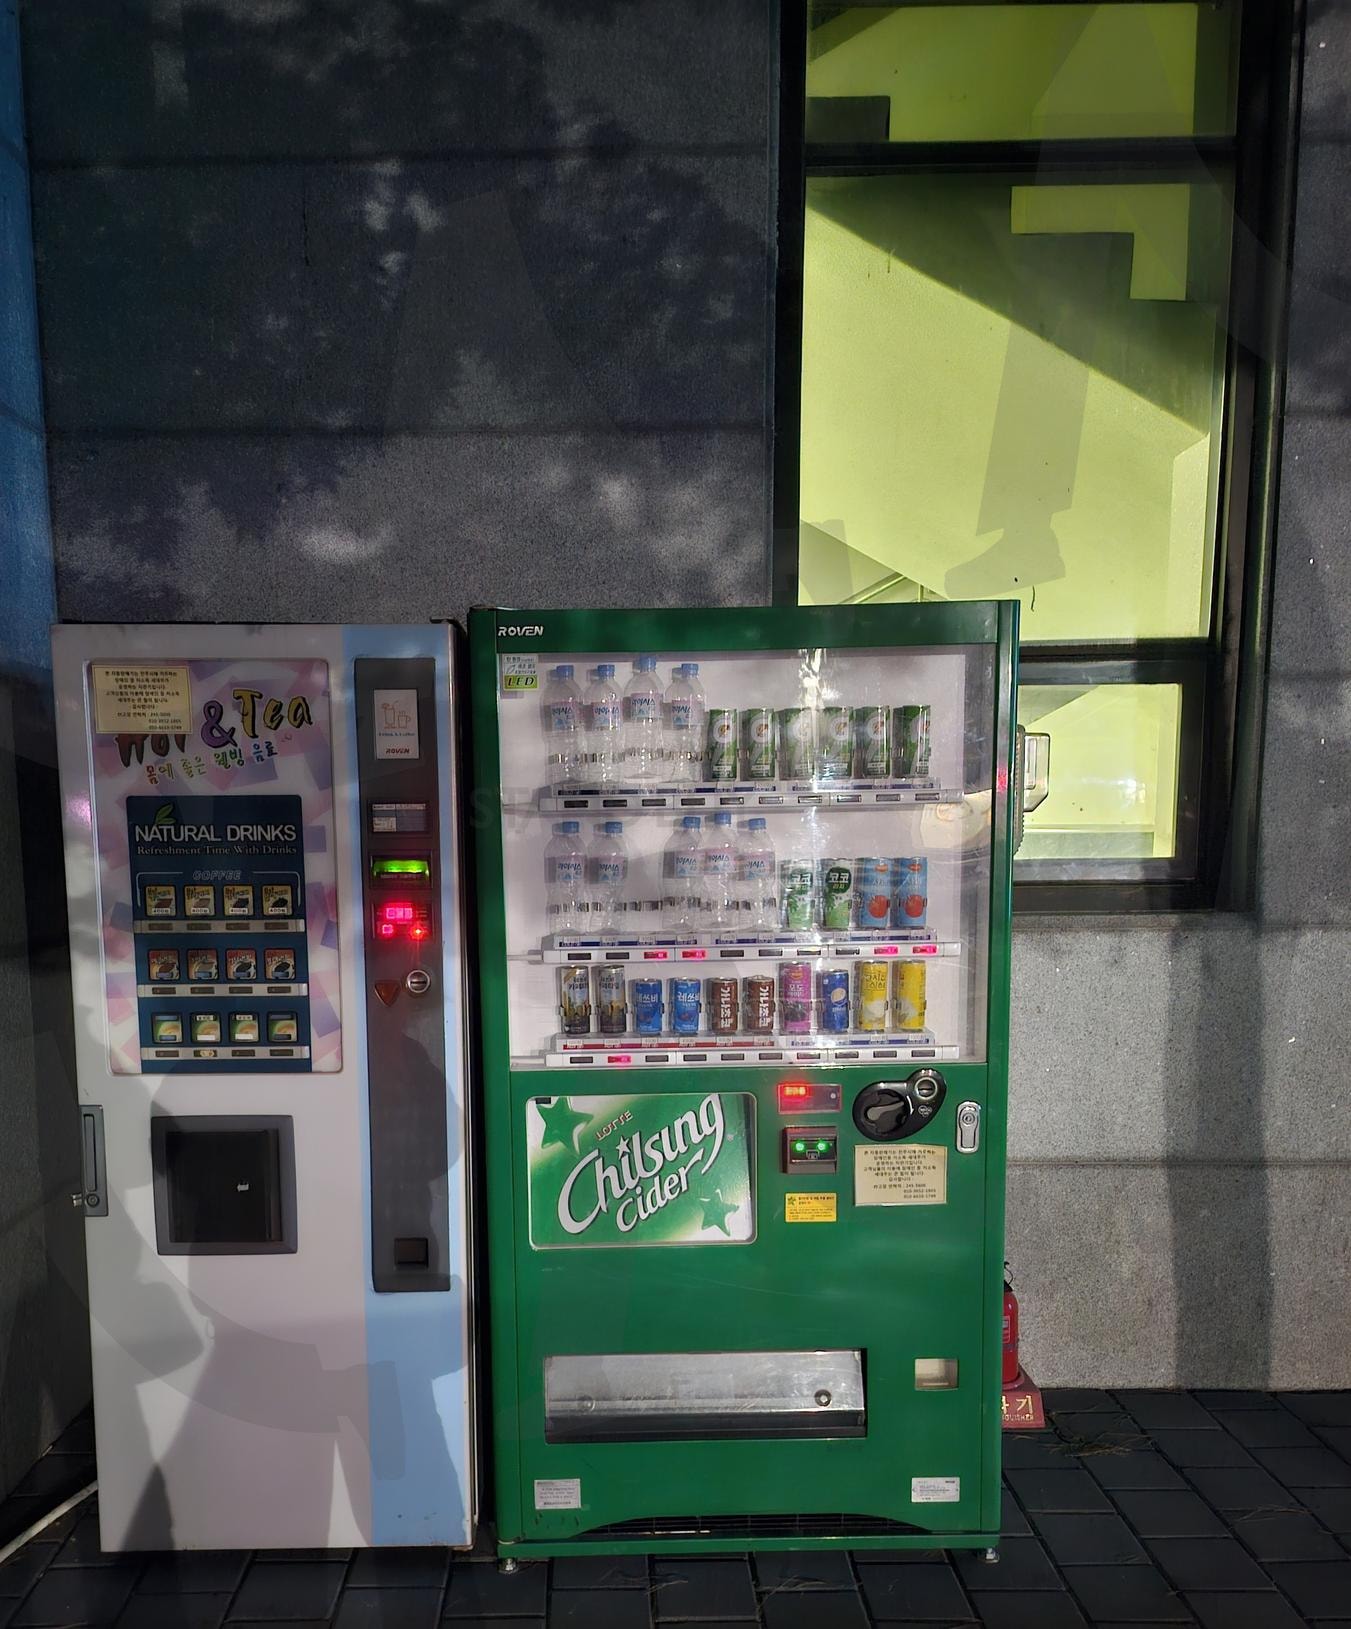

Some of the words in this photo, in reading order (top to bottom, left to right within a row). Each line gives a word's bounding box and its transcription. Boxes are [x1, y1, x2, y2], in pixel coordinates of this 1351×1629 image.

[498, 626, 544, 637] ROVEN
[508, 677, 534, 686] LED
[201, 700, 238, 748] &
[233, 689, 314, 739] Tea
[146, 763, 175, 785] 몸에
[213, 749, 245, 770] 웰빙
[252, 741, 278, 763] 음료
[135, 825, 222, 842] NATURAL
[227, 824, 297, 841] DRINKS
[137, 845, 200, 855] Refreshment
[206, 845, 231, 855] Time
[233, 845, 260, 855] With
[262, 845, 297, 854] Drinks
[193, 870, 242, 880] COFFEE
[790, 873, 811, 885] 코코
[828, 872, 849, 883] 코코
[596, 1110, 633, 1141] LOTTE
[557, 1093, 725, 1234] Chilsung
